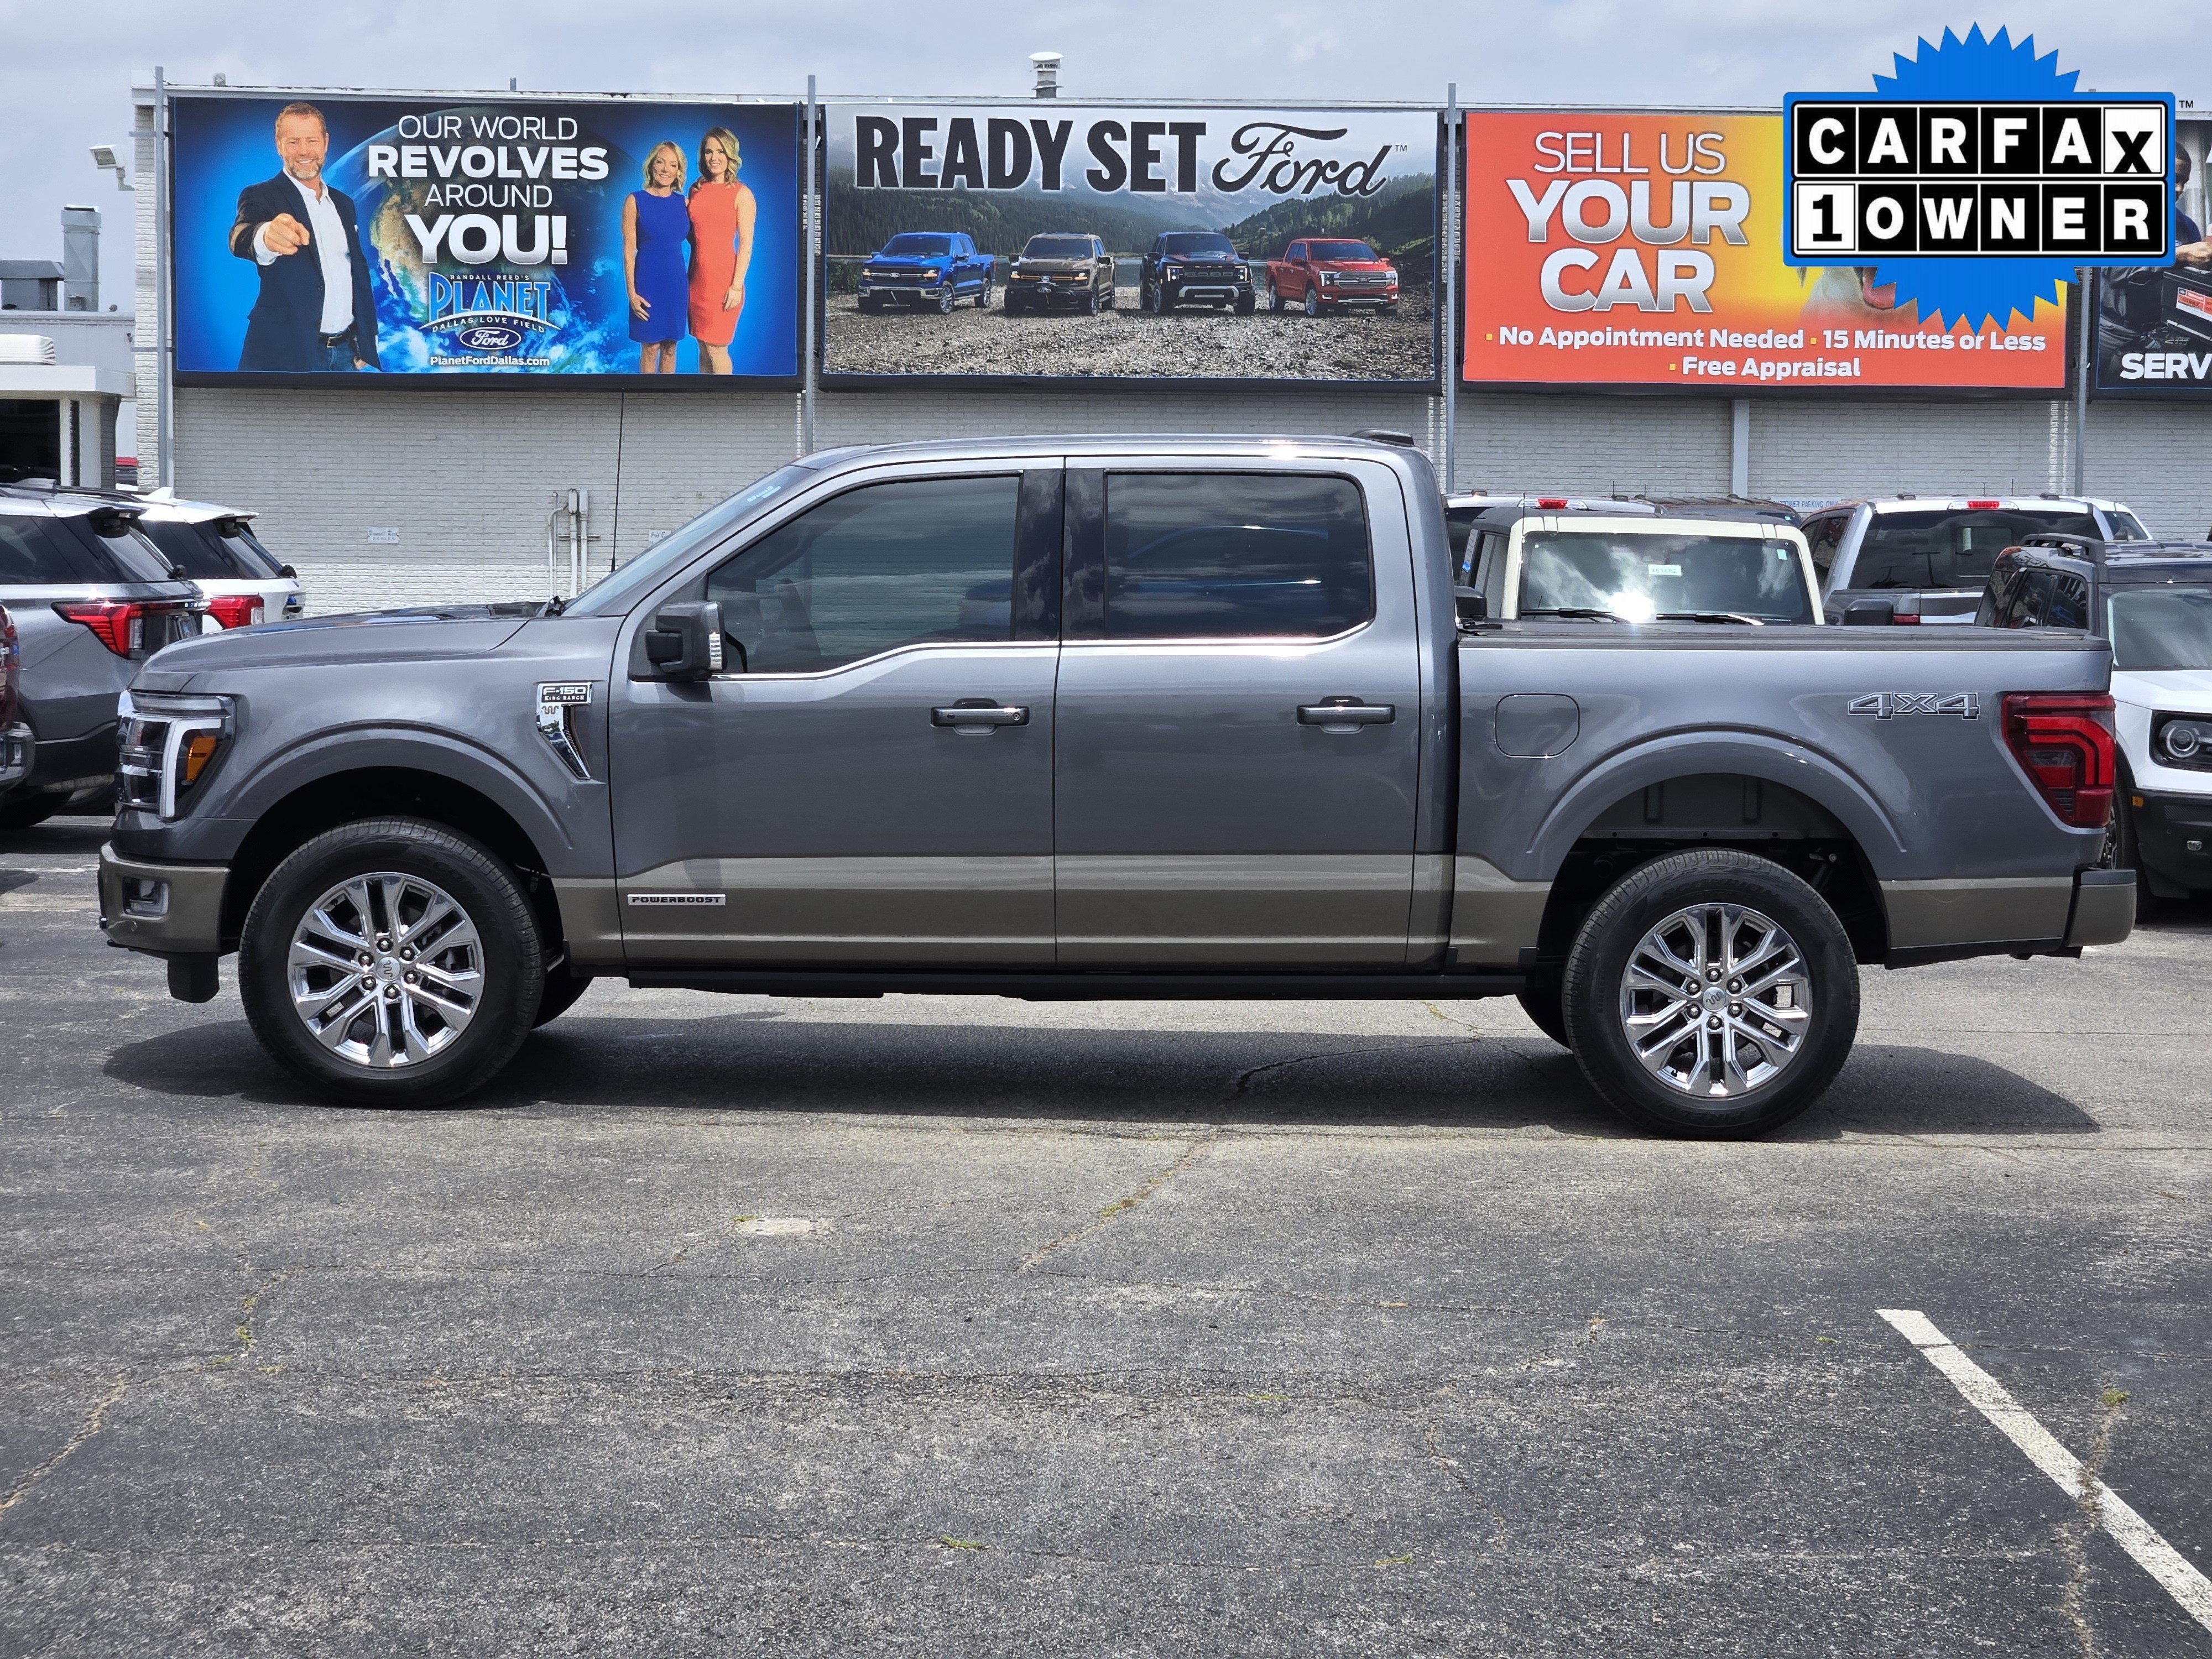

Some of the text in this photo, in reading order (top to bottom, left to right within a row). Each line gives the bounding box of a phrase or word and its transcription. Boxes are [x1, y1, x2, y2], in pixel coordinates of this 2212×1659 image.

[398, 115, 577, 140] OUR WORLD
[368, 145, 609, 180] REVOLVES
[856, 116, 1073, 190] READY
[1087, 121, 1206, 193] SET
[1212, 122, 1392, 196] Ford
[1534, 132, 1726, 174] SELL US
[425, 184, 552, 207] AROUND
[1506, 179, 1750, 245] YOUR
[404, 213, 568, 265] YOU!
[1541, 248, 1713, 312] CAR
[429, 272, 551, 323] PLANET
[432, 316, 473, 333] DALLAS
[514, 319, 545, 333] FIELD
[471, 330, 509, 346] Ford
[1499, 326, 2046, 351] No Appointment Needed 15 Minutes or Less
[430, 356, 550, 366] PlanetFordDallas.com
[1682, 356, 1861, 380] Free Appraisal
[543, 686, 586, 695] F-150
